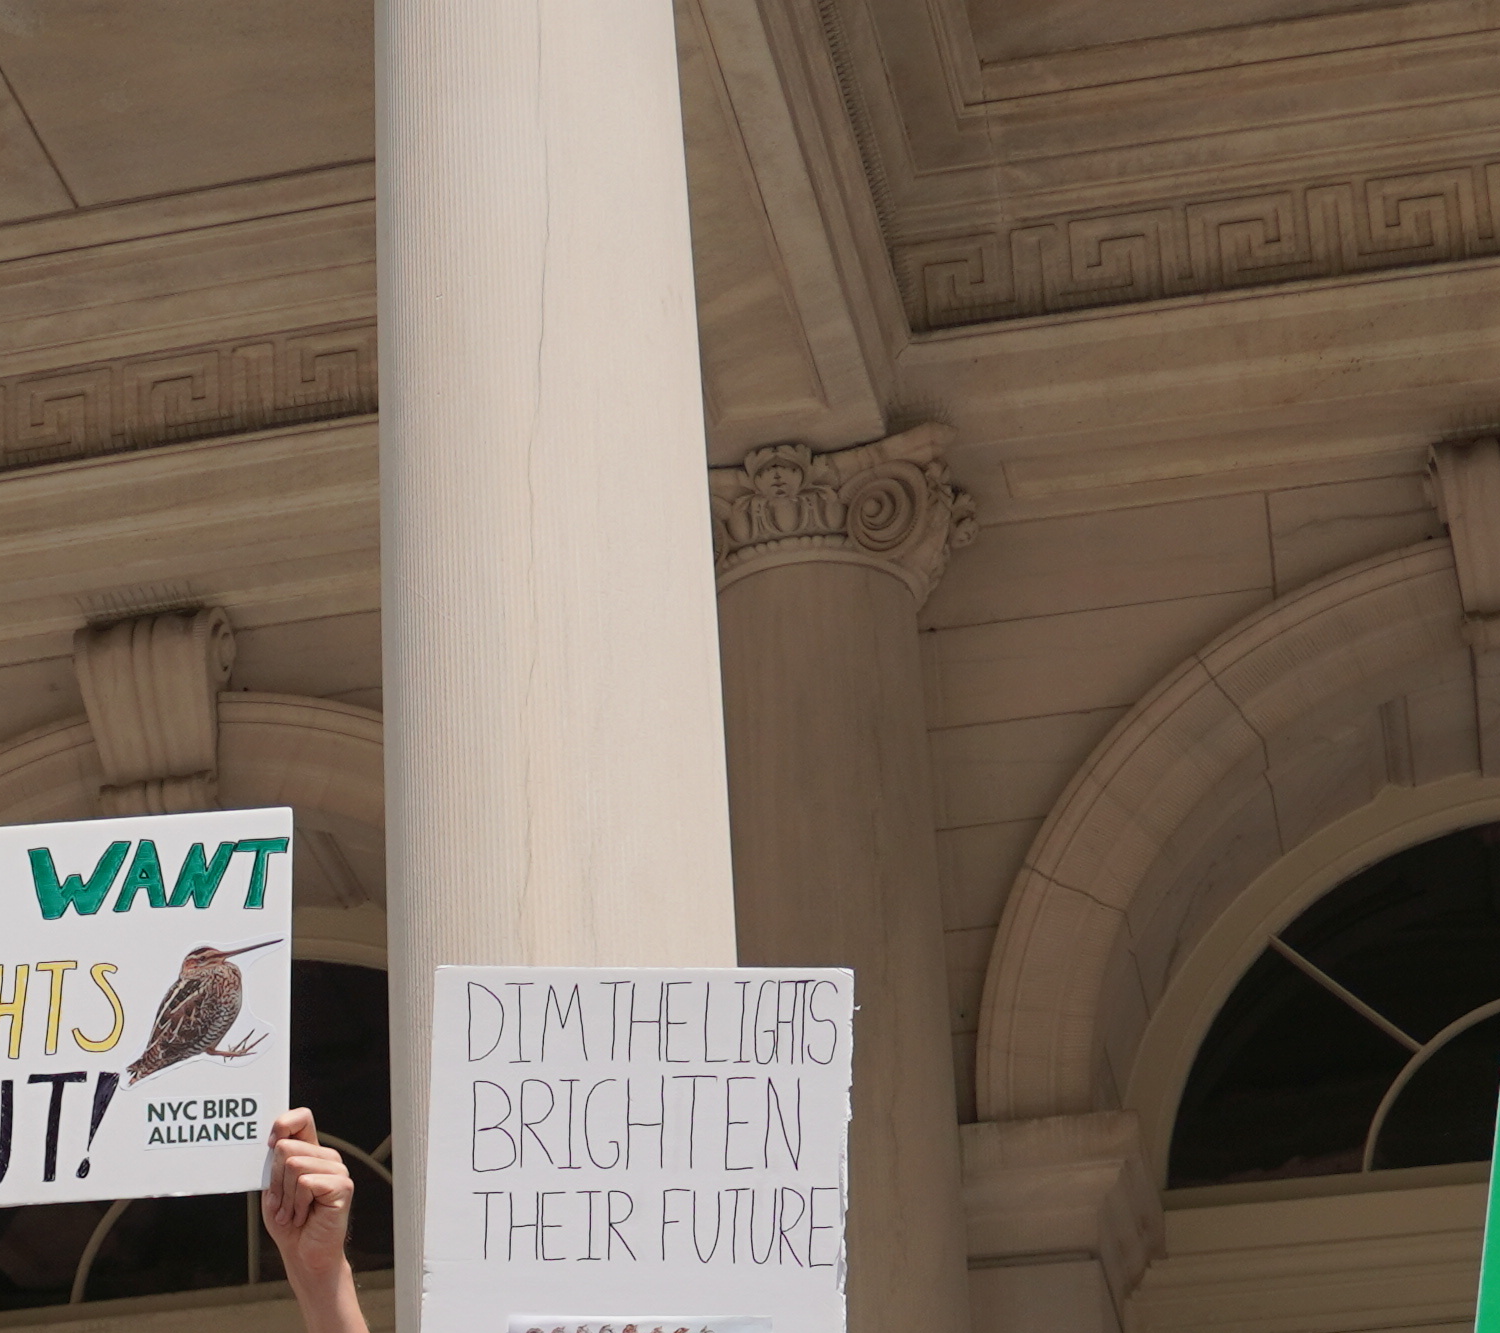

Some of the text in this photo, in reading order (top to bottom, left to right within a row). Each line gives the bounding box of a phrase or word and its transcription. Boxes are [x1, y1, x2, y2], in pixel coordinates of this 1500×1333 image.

[28, 837, 289, 919] WANT
[467, 979, 839, 1065] DIM THE LIGHTS
[147, 1097, 259, 1122] NYC BIRD
[147, 1121, 259, 1145] ALLIANCE
[472, 1074, 803, 1172] BRIGHTEN
[472, 1186, 840, 1268] THEIR FUTURE
